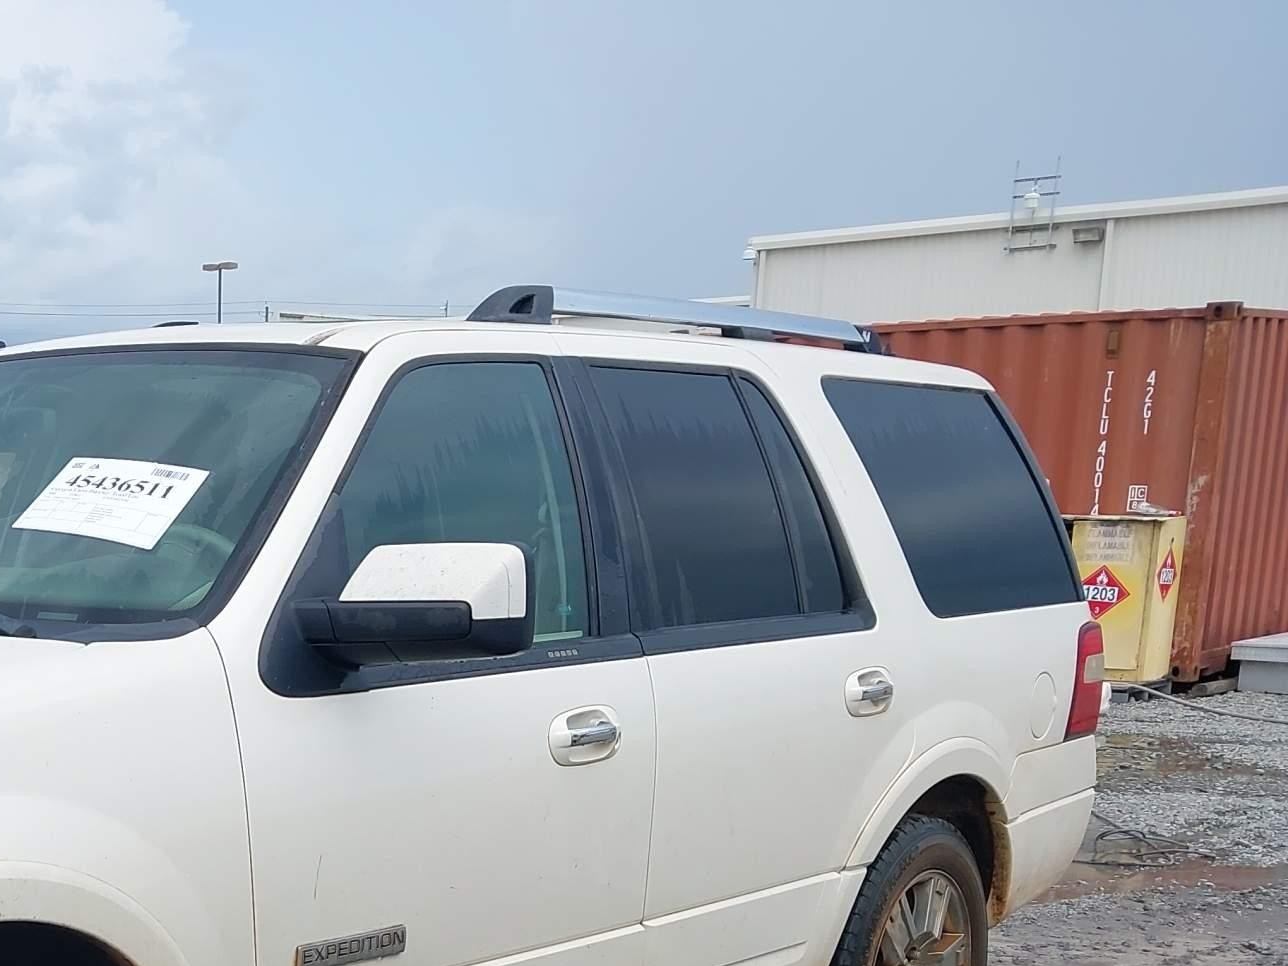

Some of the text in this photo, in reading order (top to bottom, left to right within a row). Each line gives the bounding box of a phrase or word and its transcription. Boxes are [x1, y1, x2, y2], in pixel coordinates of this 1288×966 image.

[1099, 370, 1115, 435] TCLU
[1143, 369, 1157, 435] 42G1
[65, 474, 174, 499] 45436511
[1085, 587, 1116, 602] 1203
[303, 929, 405, 965] EXPEDITION
